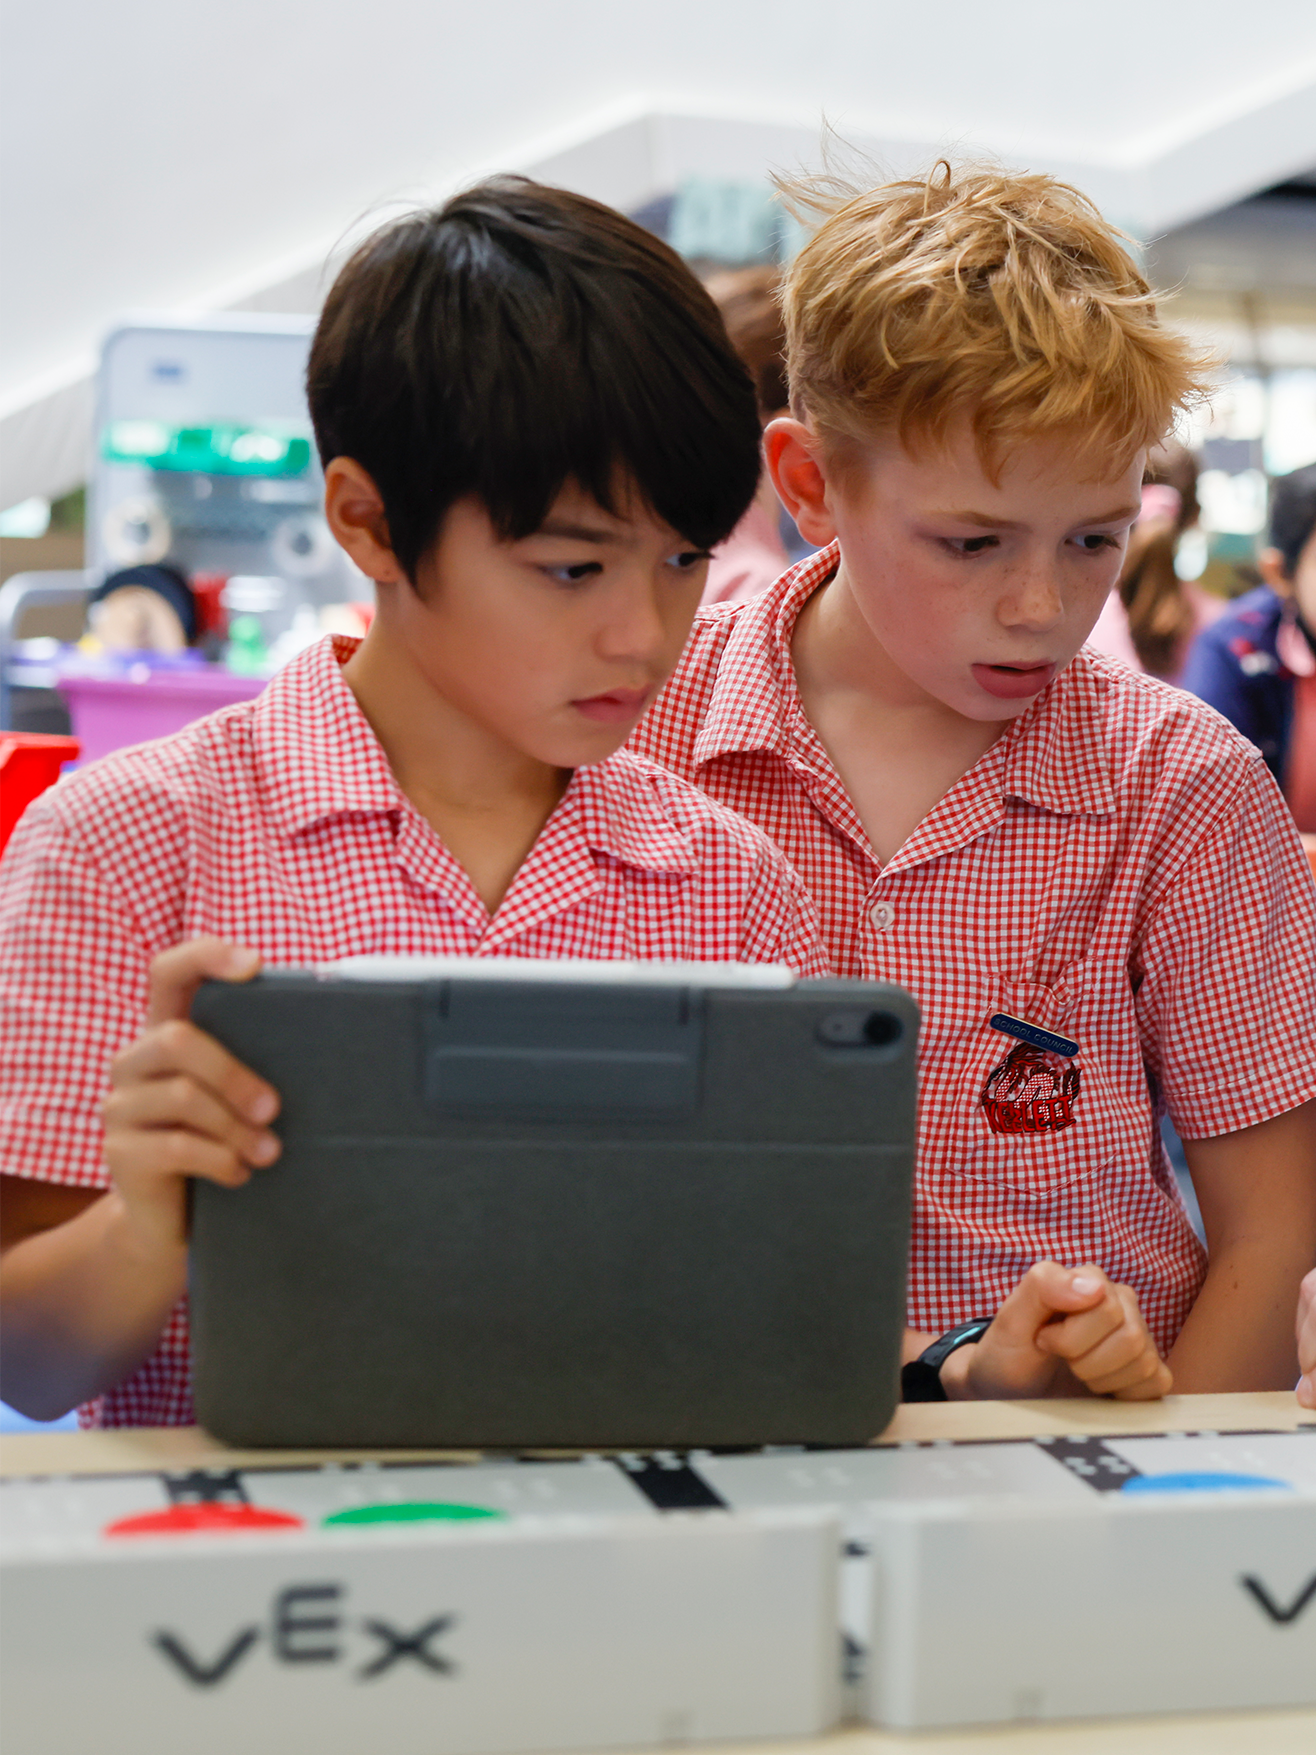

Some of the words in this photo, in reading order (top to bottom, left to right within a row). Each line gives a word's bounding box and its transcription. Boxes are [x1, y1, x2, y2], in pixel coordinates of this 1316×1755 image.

[993, 1017, 1032, 1039] SCHOOL
[1033, 1032, 1074, 1055] COUNCIL
[982, 1095, 1074, 1135] KELLETT
[150, 1582, 459, 1688] VEX
